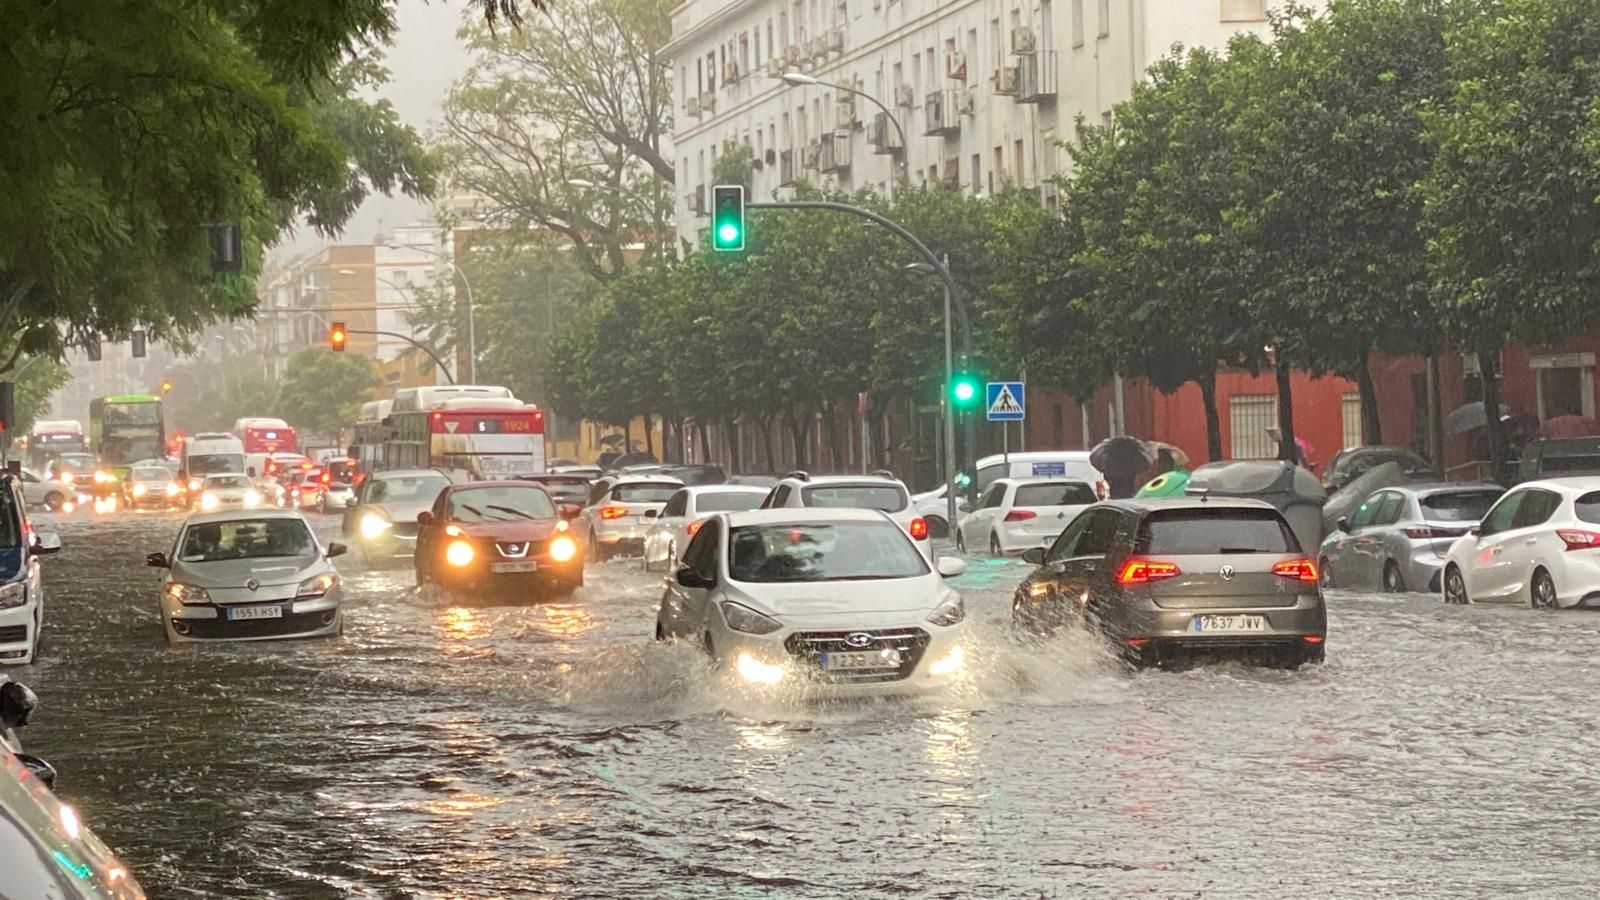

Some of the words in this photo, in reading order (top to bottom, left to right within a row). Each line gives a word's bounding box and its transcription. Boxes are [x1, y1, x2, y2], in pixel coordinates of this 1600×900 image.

[505, 420, 529, 432] 1924
[235, 607, 258, 618] 1551
[260, 607, 279, 617] HSY
[1202, 617, 1233, 629] 7637
[1239, 617, 1260, 629] JWV
